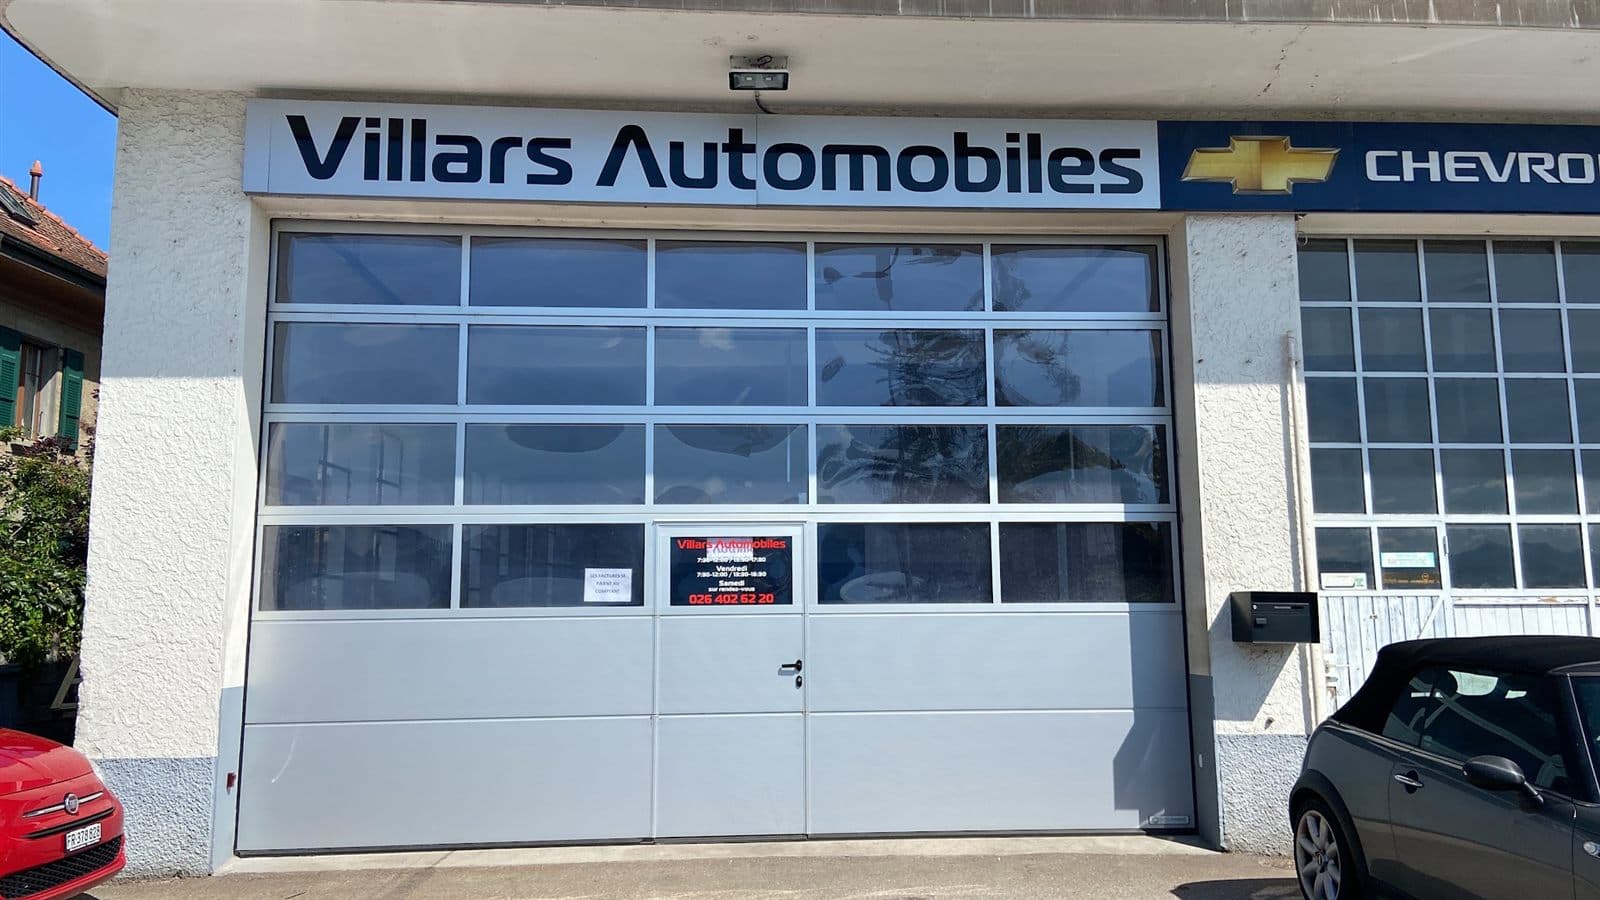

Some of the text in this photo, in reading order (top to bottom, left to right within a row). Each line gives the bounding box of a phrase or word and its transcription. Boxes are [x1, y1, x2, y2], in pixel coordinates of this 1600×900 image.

[286, 115, 1143, 194] Villars Automobiles
[1365, 150, 1600, 184] CHEVRO
[677, 539, 786, 549] Villars Automobiles
[689, 593, 774, 605] 026 402 62 20
